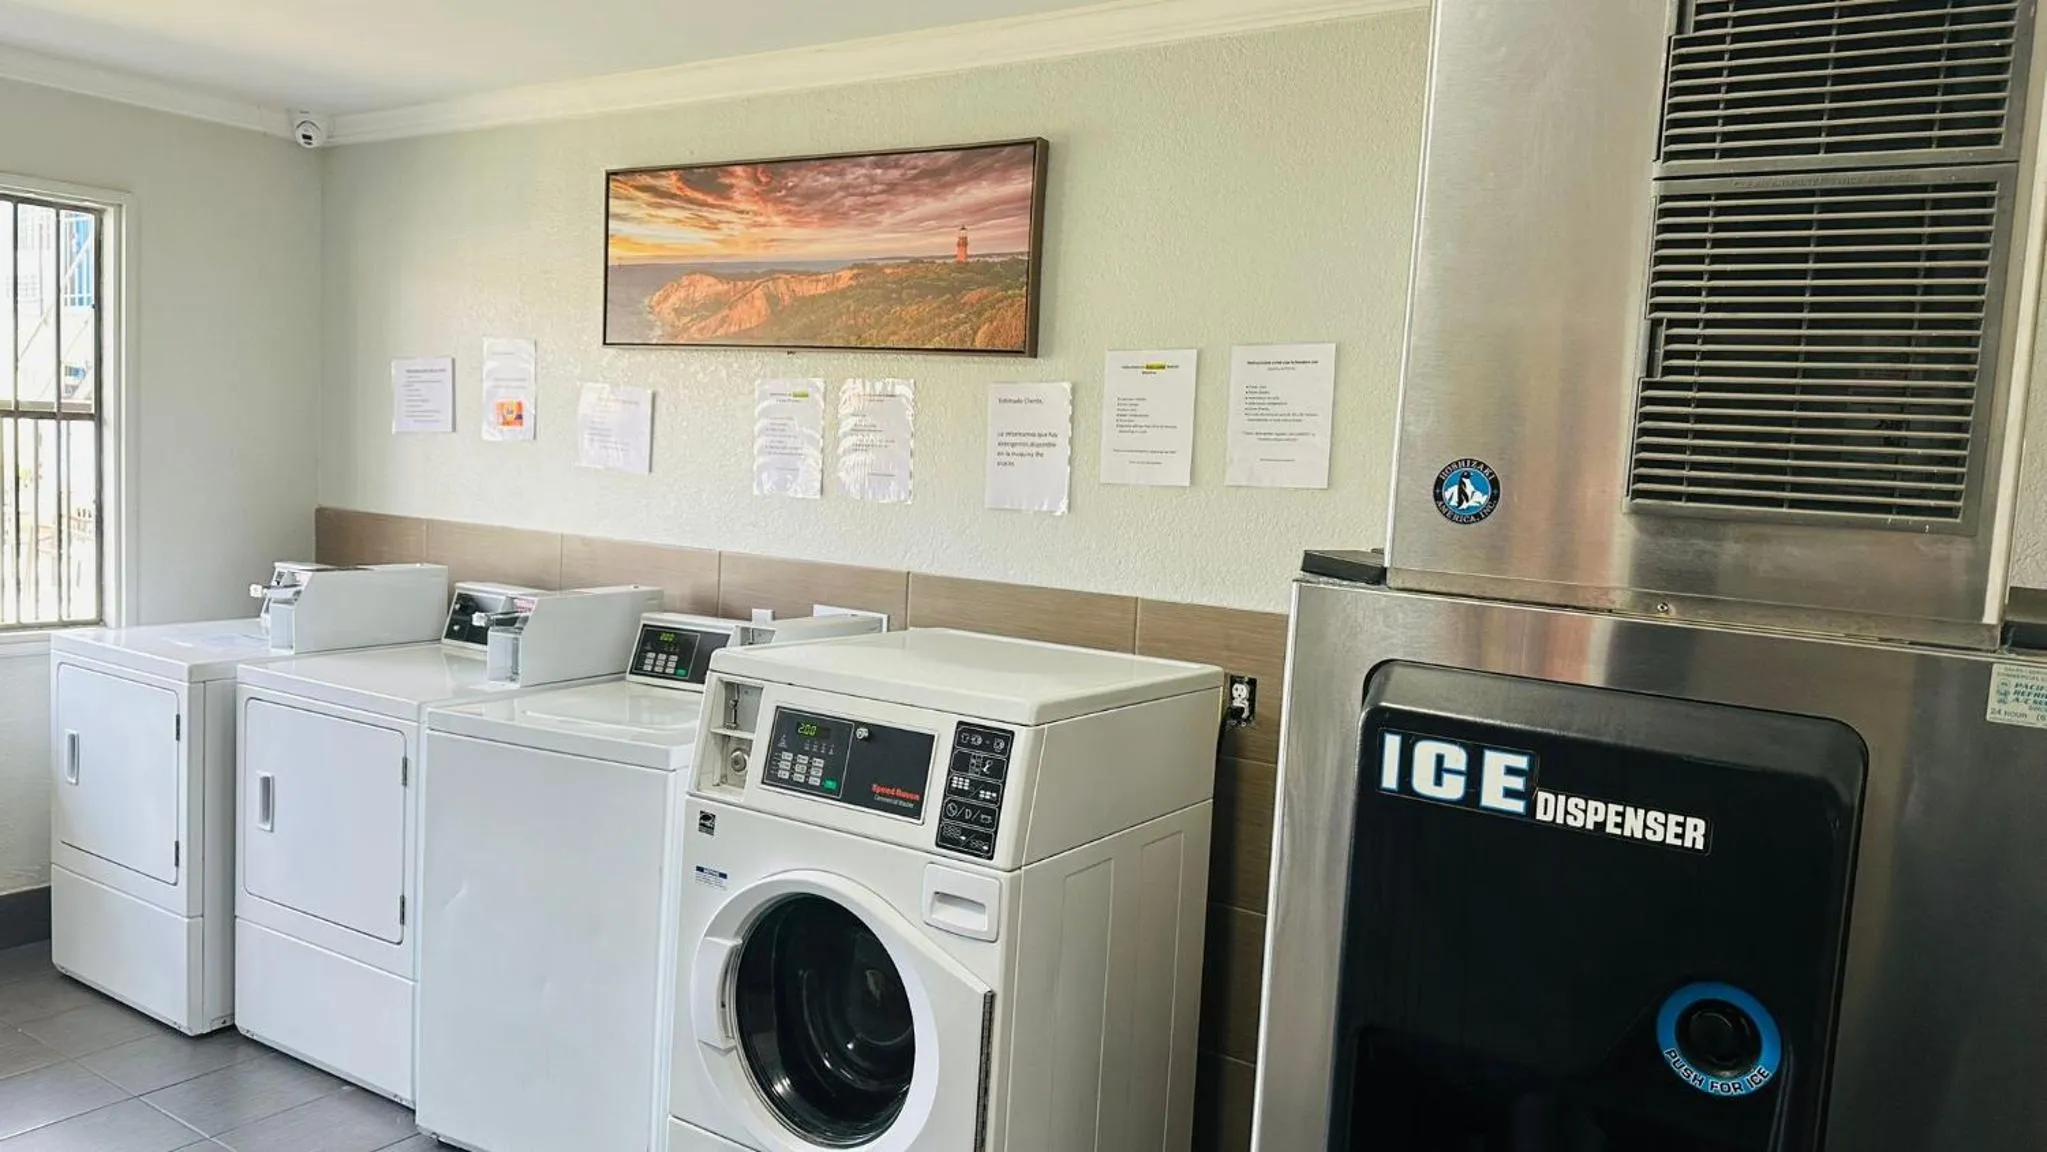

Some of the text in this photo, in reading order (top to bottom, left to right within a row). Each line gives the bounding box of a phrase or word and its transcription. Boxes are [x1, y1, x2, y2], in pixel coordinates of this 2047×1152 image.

[1439, 460, 1496, 480] HOSHIZAKI
[1380, 732, 1707, 851] ICE DISPENSER
[1664, 1047, 1773, 1096] PUSH FOR ICE
